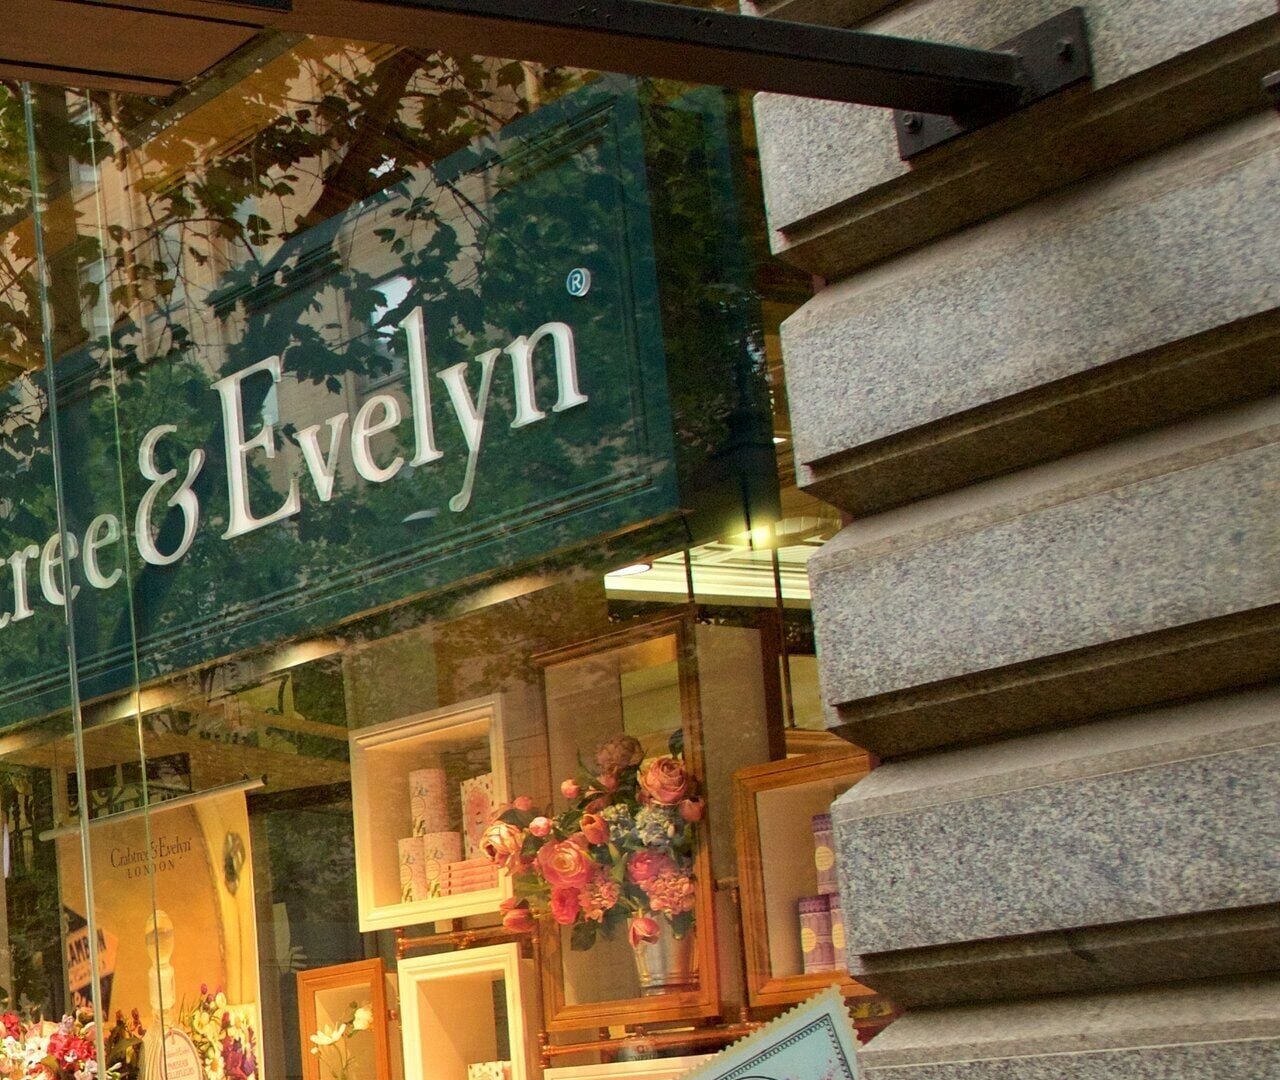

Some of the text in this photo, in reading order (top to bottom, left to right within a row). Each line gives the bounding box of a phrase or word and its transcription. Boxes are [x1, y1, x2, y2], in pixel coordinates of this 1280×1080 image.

[135, 424, 205, 566] &
[210, 306, 588, 541] Evelyn
[127, 859, 175, 879] LONDON
